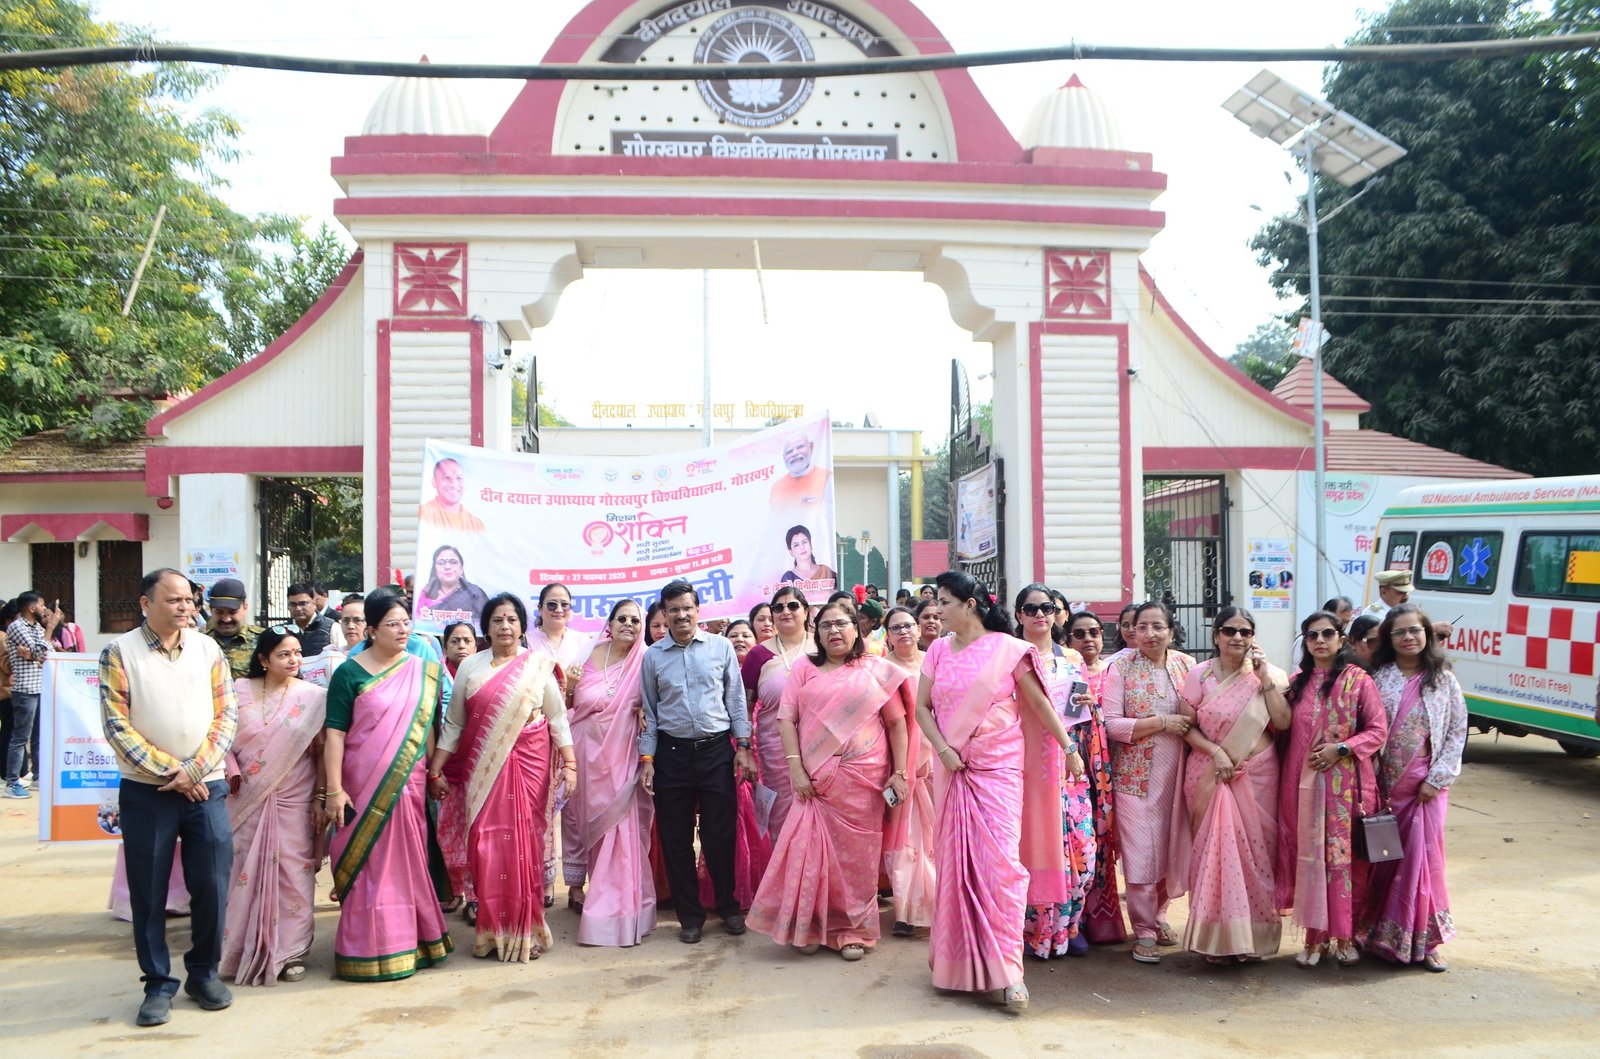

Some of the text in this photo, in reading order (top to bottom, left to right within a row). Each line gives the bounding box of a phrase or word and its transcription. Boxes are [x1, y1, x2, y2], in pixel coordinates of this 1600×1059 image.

[633, 0, 731, 42] दीनदयाल
[786, 0, 879, 49] उपाध्याय
[621, 132, 707, 158] गोरखपर
[815, 136, 888, 161] गोरखपर
[480, 487, 503, 503] दीन
[507, 492, 542, 505] दयाल
[599, 492, 648, 509] गोरखपुर
[651, 480, 727, 504] विश्वविद्यालय,
[730, 464, 776, 487] गोरखपुर
[1473, 489, 1531, 503] Ambulance
[1532, 485, 1575, 500] Service
[1577, 485, 1600, 499] (NA
[606, 513, 637, 522] मिशन
[614, 511, 689, 556] शक्ति
[1391, 545, 1412, 562] 102
[1339, 559, 1367, 575] जन
[1440, 628, 1502, 656] LANCE
[1508, 673, 1572, 695] 102 (Toll Free)
[64, 750, 116, 767] The Assoc
